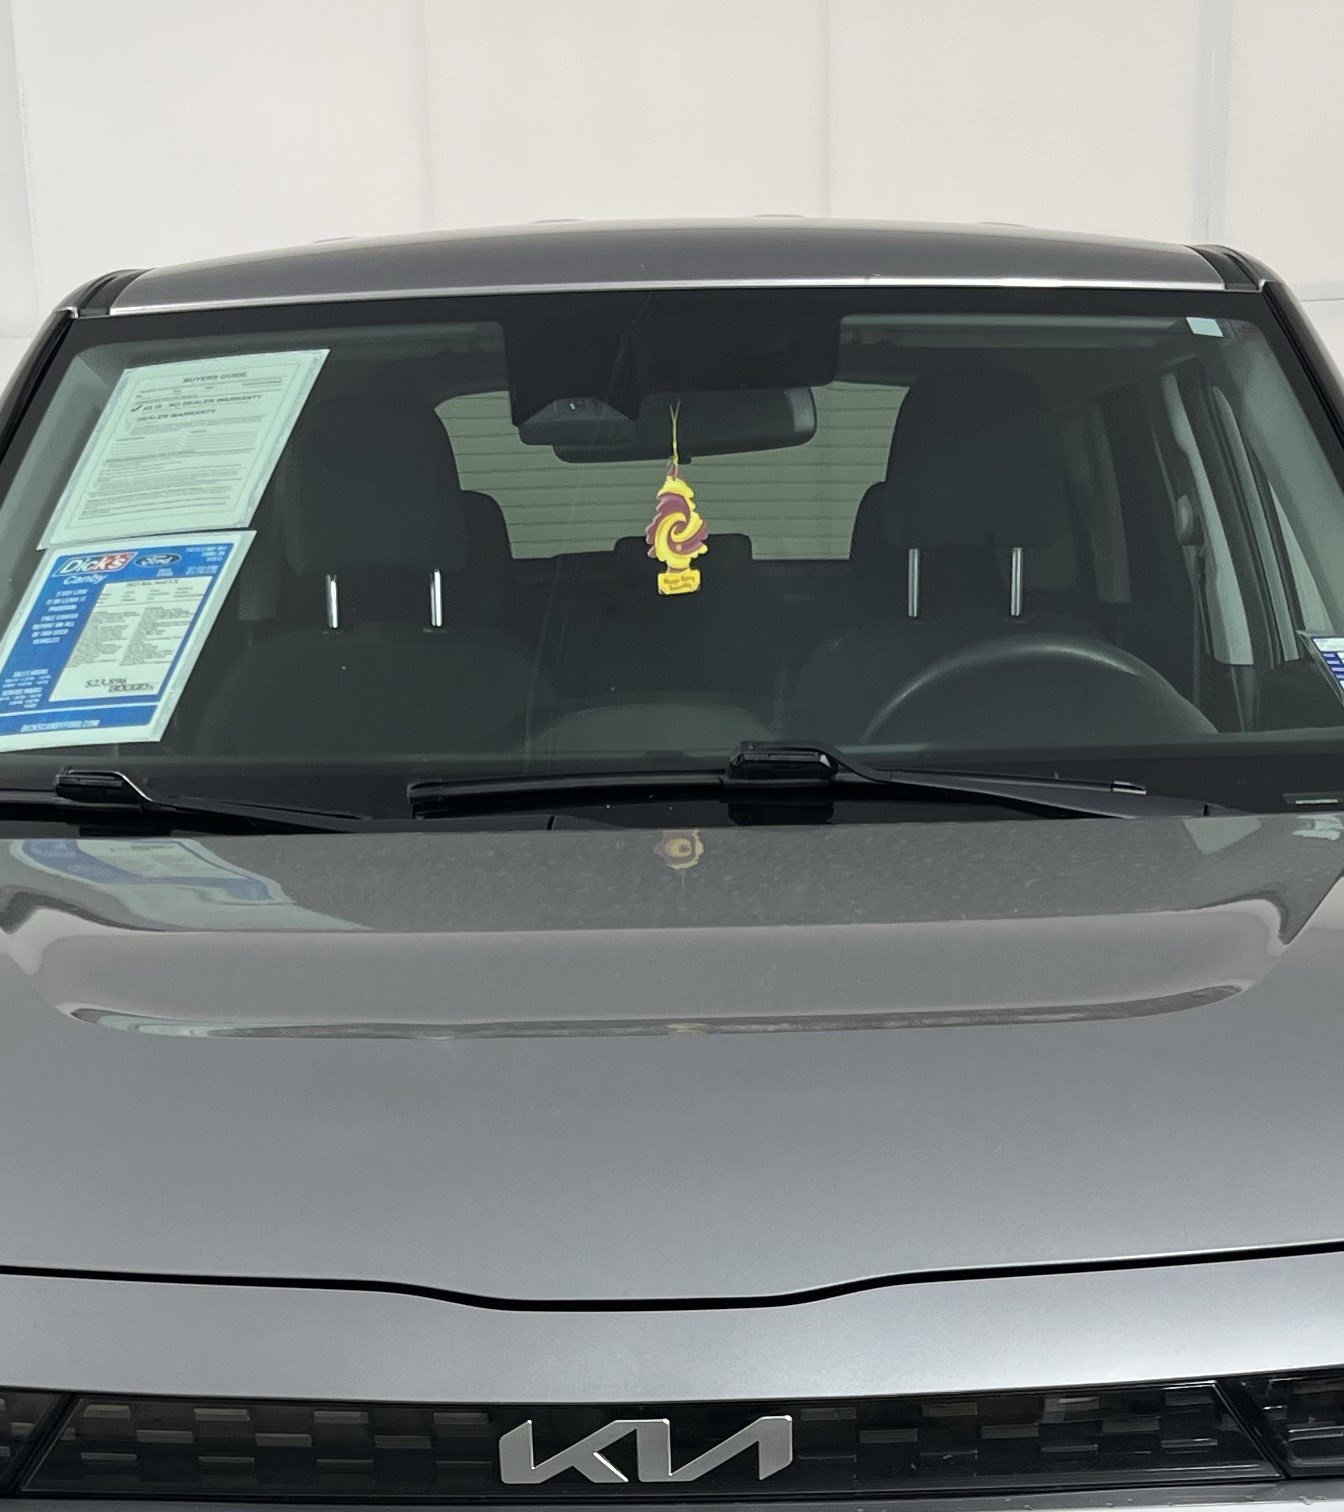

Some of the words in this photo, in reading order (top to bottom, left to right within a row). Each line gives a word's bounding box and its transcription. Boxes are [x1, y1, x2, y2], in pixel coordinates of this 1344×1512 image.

[220, 371, 248, 380] GUIDE
[59, 555, 128, 574] Dick's
[499, 1415, 793, 1484] KIA
